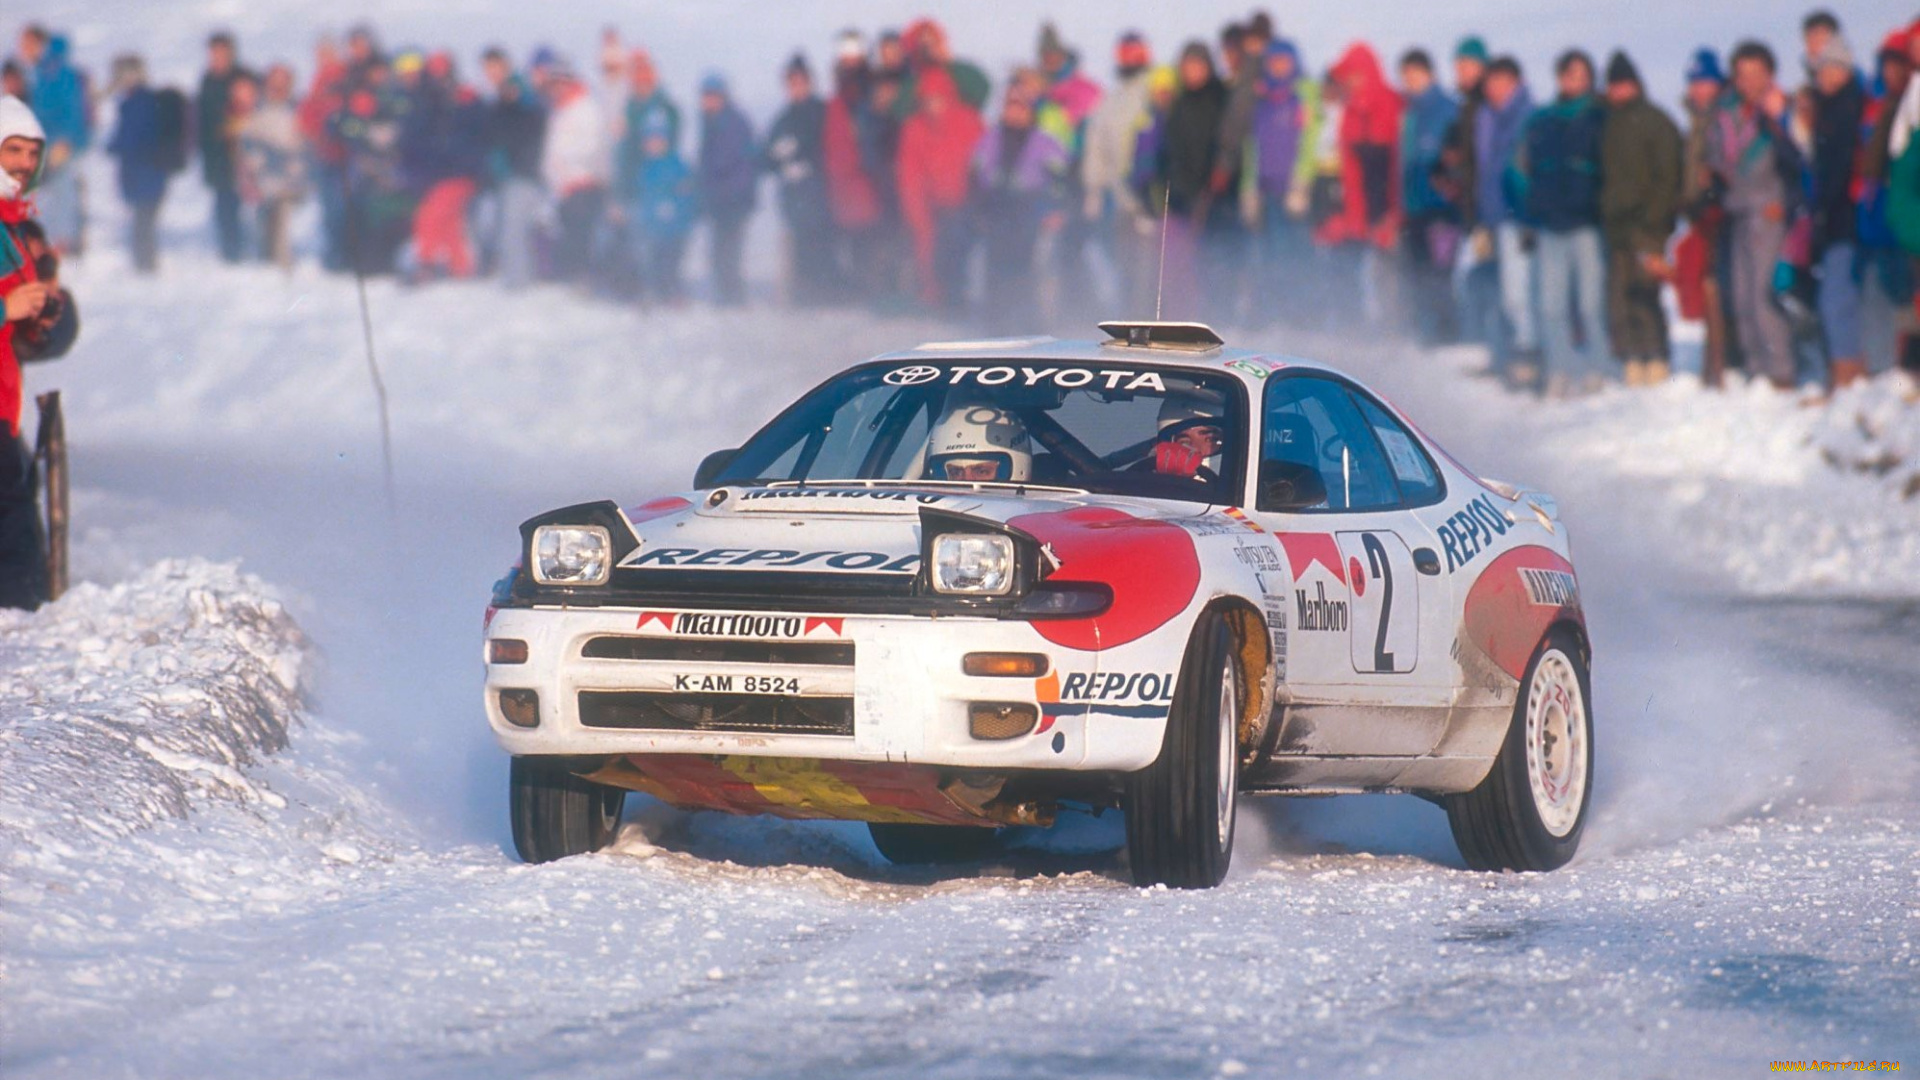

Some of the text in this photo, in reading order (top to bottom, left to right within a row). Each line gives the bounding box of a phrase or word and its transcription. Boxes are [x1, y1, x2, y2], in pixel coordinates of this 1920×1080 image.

[949, 366, 1166, 392] TOYOTA
[1436, 492, 1515, 575] REPSOL
[624, 548, 920, 571] REPSOL
[1295, 581, 1348, 632] Marlboro
[1361, 532, 1394, 671] 2
[675, 613, 800, 637] Marlboro
[675, 674, 800, 694] K-AM 8524
[1061, 672, 1173, 701] REPSOL
